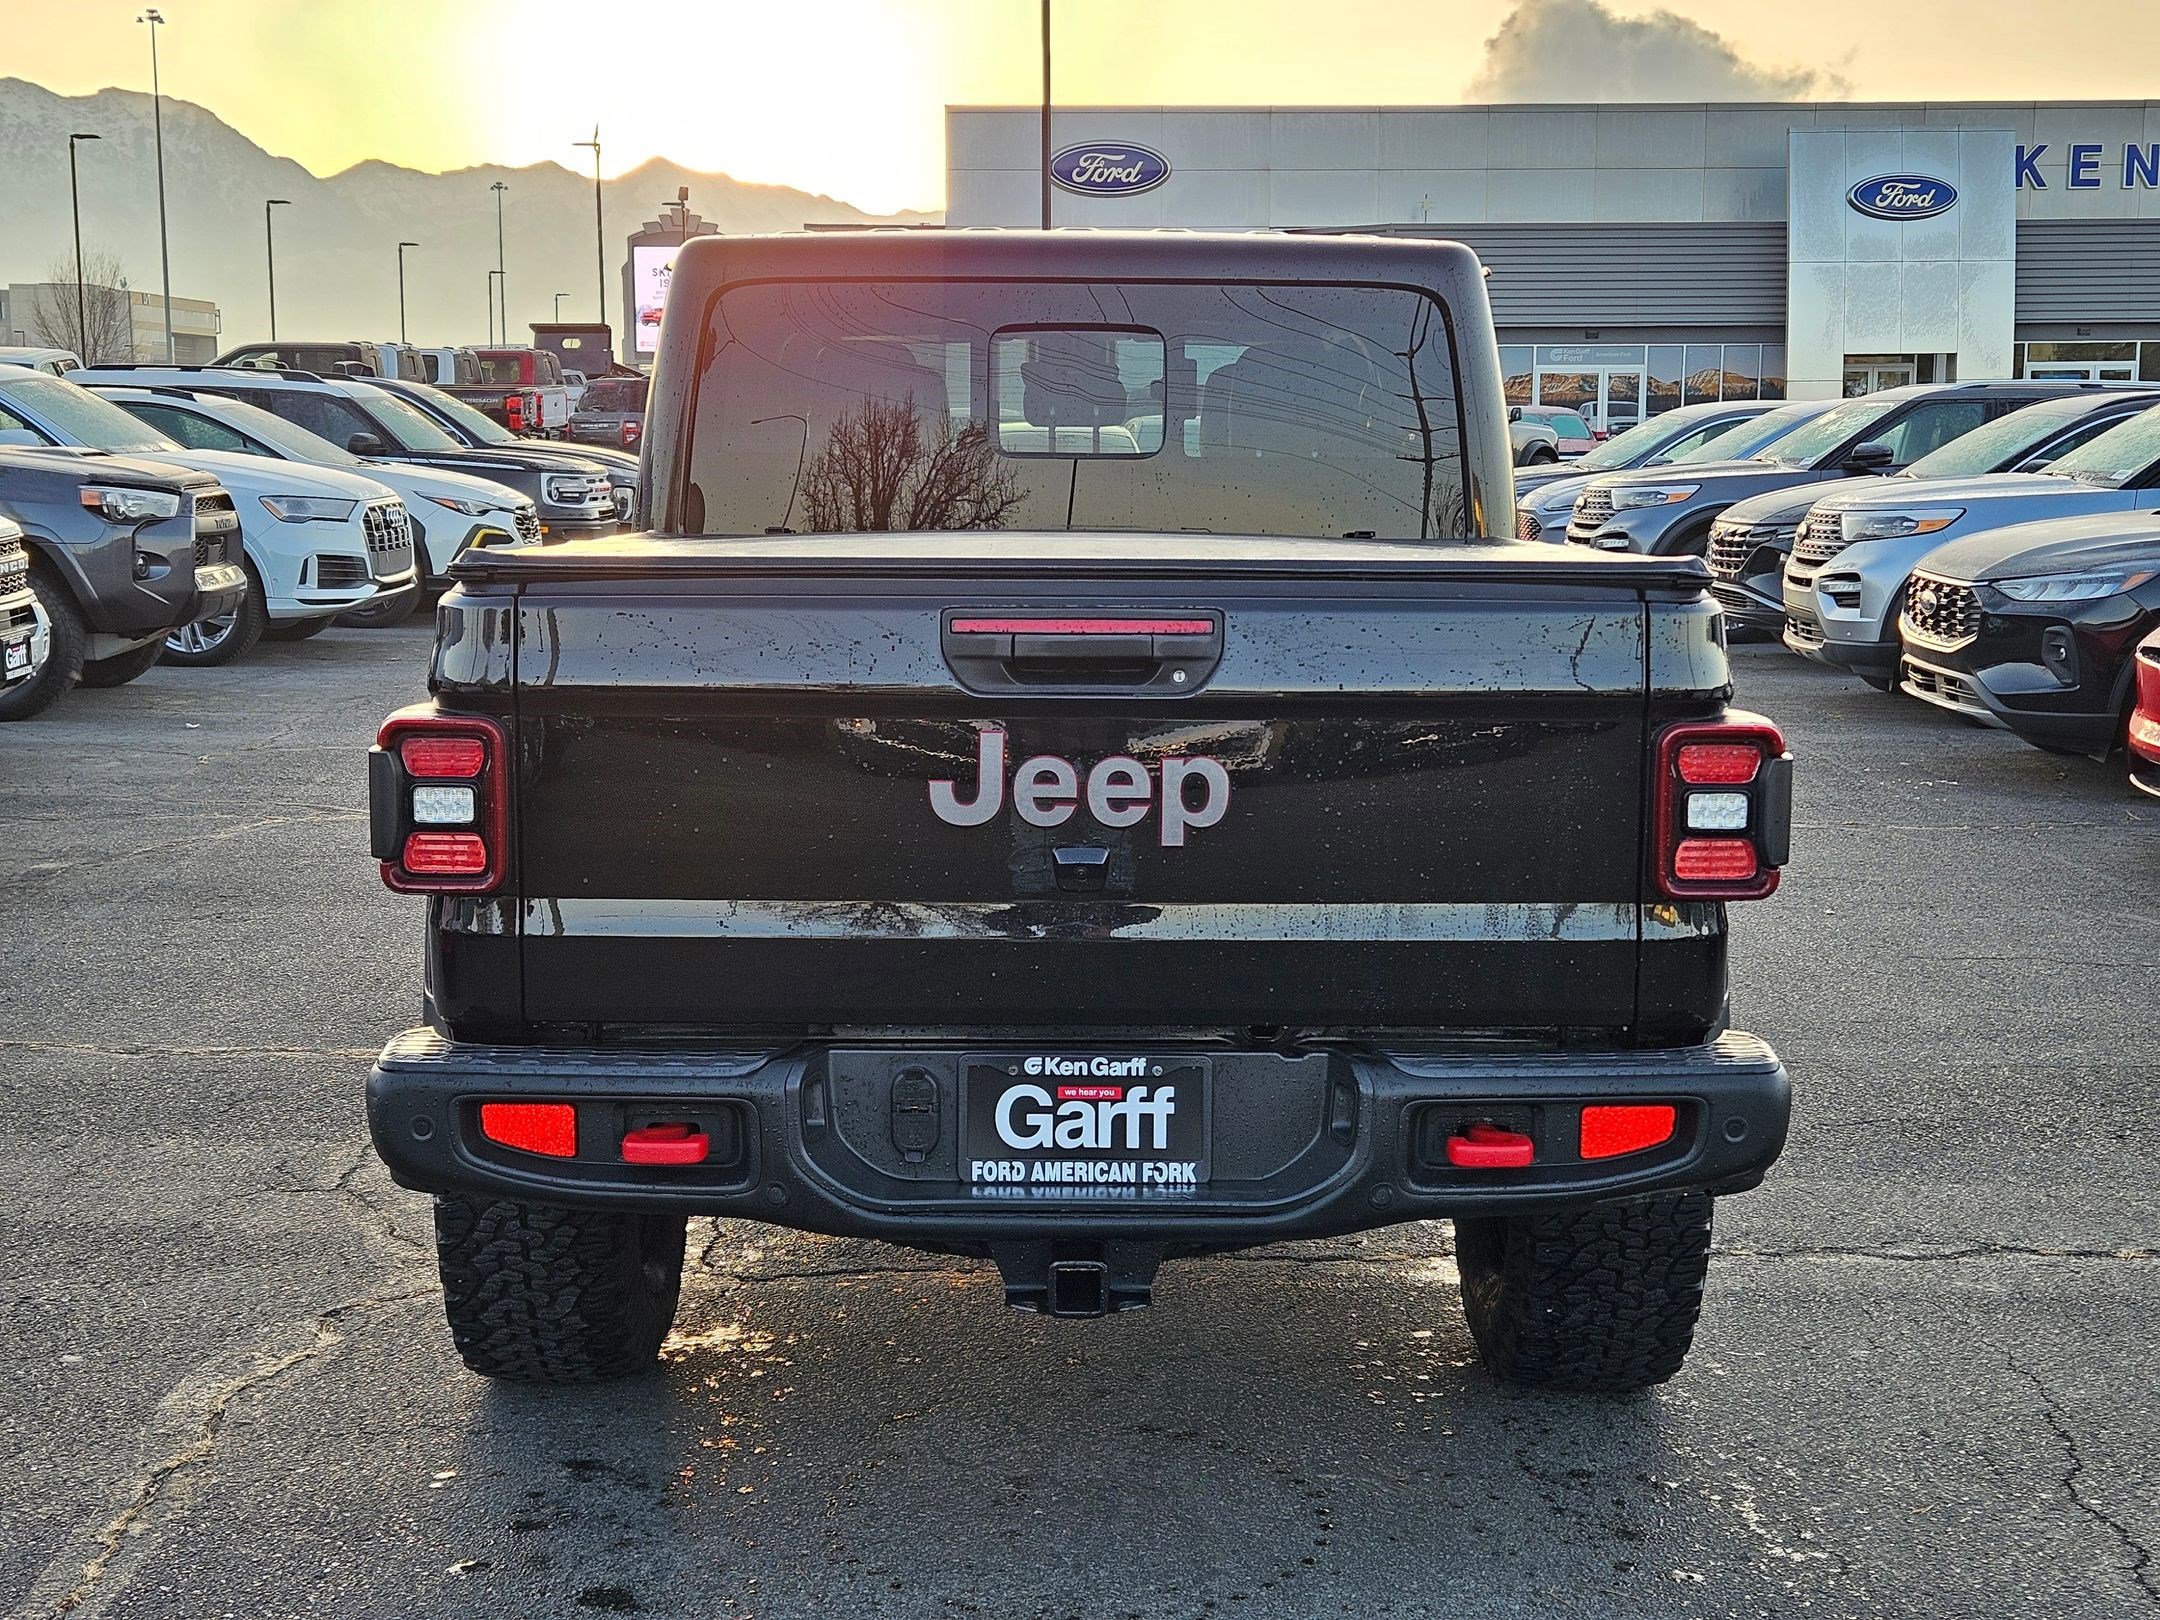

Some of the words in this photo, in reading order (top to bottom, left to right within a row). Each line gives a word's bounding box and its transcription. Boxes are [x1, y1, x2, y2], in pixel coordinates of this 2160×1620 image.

[1071, 152, 1144, 183] Ford
[2015, 142, 2160, 190] KEN
[1875, 181, 1936, 208] Ford
[1563, 354, 1583, 362] Ford
[929, 730, 1230, 847] Jeep
[1045, 1056, 1087, 1076] Ken
[1090, 1057, 1147, 1077] Garff
[1078, 1087, 1098, 1096] hear
[1098, 1089, 1115, 1098] you
[994, 1083, 1175, 1150] Garff
[971, 1160, 1026, 1182] FORD
[1030, 1161, 1137, 1183] AMERICAN
[1142, 1162, 1197, 1183] FORK
